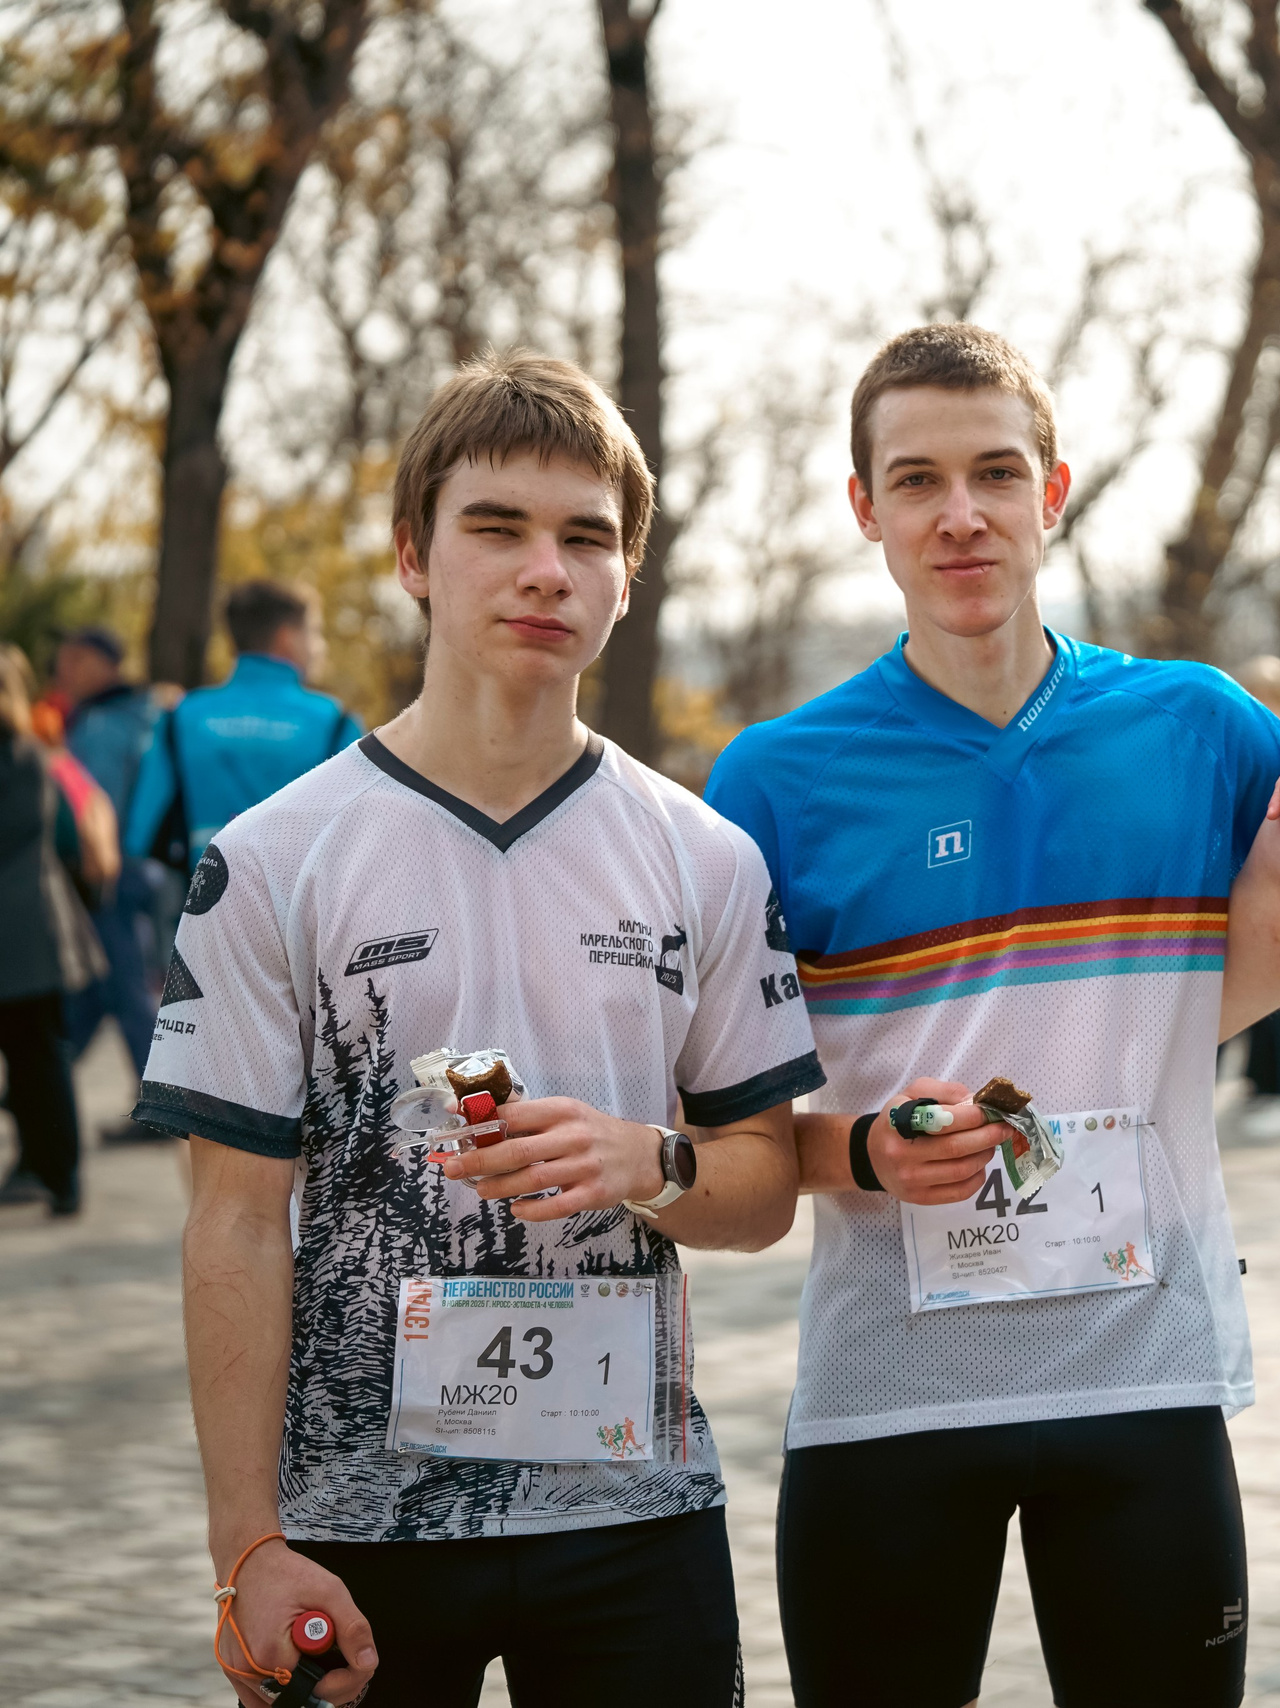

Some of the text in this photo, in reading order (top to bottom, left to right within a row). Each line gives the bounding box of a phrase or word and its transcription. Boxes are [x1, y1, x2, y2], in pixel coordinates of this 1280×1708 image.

[1017, 656, 1066, 732] noname
[358, 934, 429, 960] MS
[580, 932, 654, 953] КАРЕЛЬСКОГО
[352, 952, 422, 971] MASS SPORT
[589, 950, 654, 970] ПЕРЕШЕЙКА
[660, 971, 677, 984] 2025
[975, 1168, 1048, 1218] 42
[1091, 1182, 1104, 1213] 1
[947, 1222, 1020, 1250] МЖ20
[1044, 1239, 1067, 1249] Старт
[1072, 1235, 1101, 1245] 10:10:00
[949, 1252, 981, 1260] Жихарев
[957, 1261, 984, 1269] Москва
[978, 1265, 1008, 1276] 8520427
[443, 1281, 574, 1299] ПЕРВЕНСТВО РОССИИ
[404, 1278, 432, 1329] ЭТАП
[470, 1300, 484, 1308] 2025
[547, 1301, 574, 1309] ЧЕЛОВЕКА
[477, 1326, 554, 1380] 43
[597, 1352, 611, 1386] 1
[440, 1384, 518, 1406] МЖ20
[438, 1408, 497, 1417] Рубени Даниил
[444, 1418, 473, 1426] Москва
[540, 1409, 562, 1418] Старт
[569, 1408, 600, 1417] 10:10:00
[463, 1427, 496, 1435] 8508115
